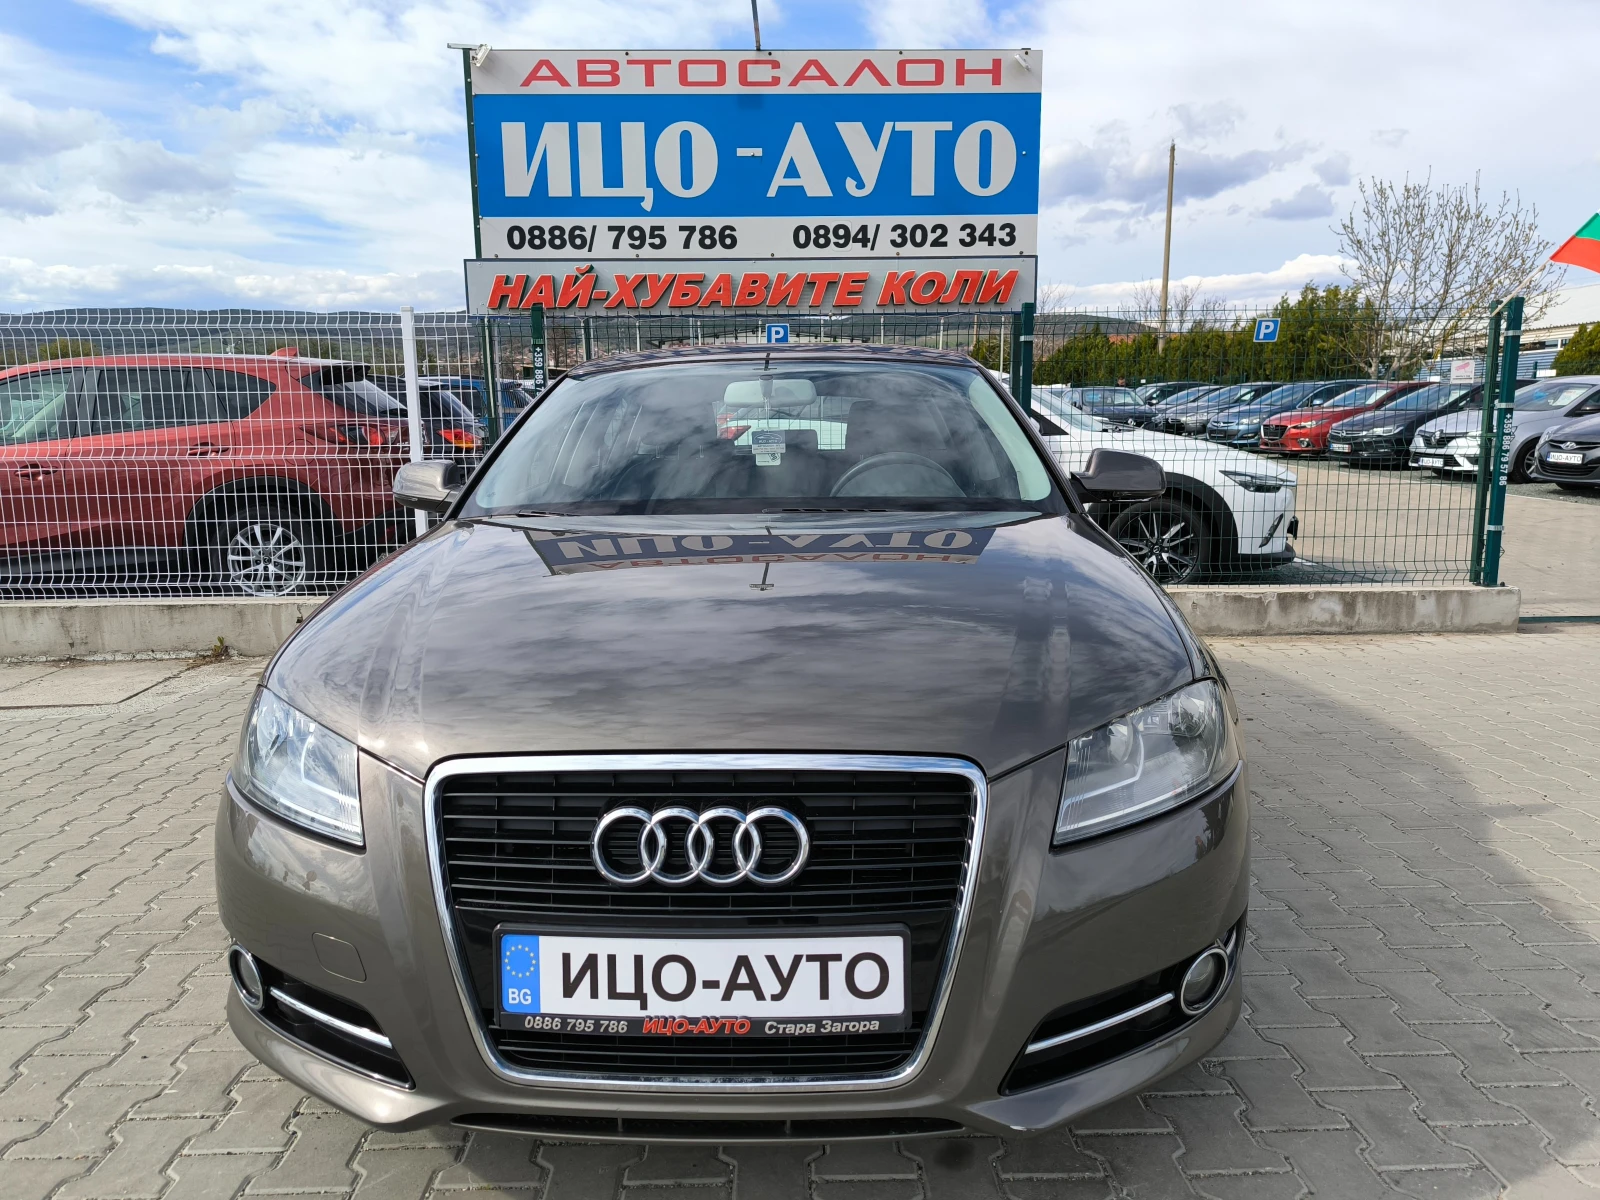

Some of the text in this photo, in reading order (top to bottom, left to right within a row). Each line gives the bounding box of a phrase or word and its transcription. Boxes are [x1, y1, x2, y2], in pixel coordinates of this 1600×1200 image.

[519, 58, 1003, 88] АВТОСАЛОН
[506, 225, 738, 252] 0886/ 795 786
[792, 223, 1017, 251] 0894/ 302 343
[486, 264, 1019, 308] НАЙ-ХУБАВИТЕ КОЛИ
[771, 326, 785, 343] P
[1258, 321, 1275, 340] P
[534, 346, 543, 367] +359
[534, 369, 544, 385] 886
[1498, 413, 1512, 486] +359 886 79 57 86
[1550, 453, 1582, 463] ИЦО-АУТО
[561, 952, 891, 1010] ИЦО-АУТО
[508, 988, 532, 1005] BG
[524, 1016, 628, 1034] 0886 795 786
[641, 1016, 880, 1036] ИЦО-АУТО Стара Загора
